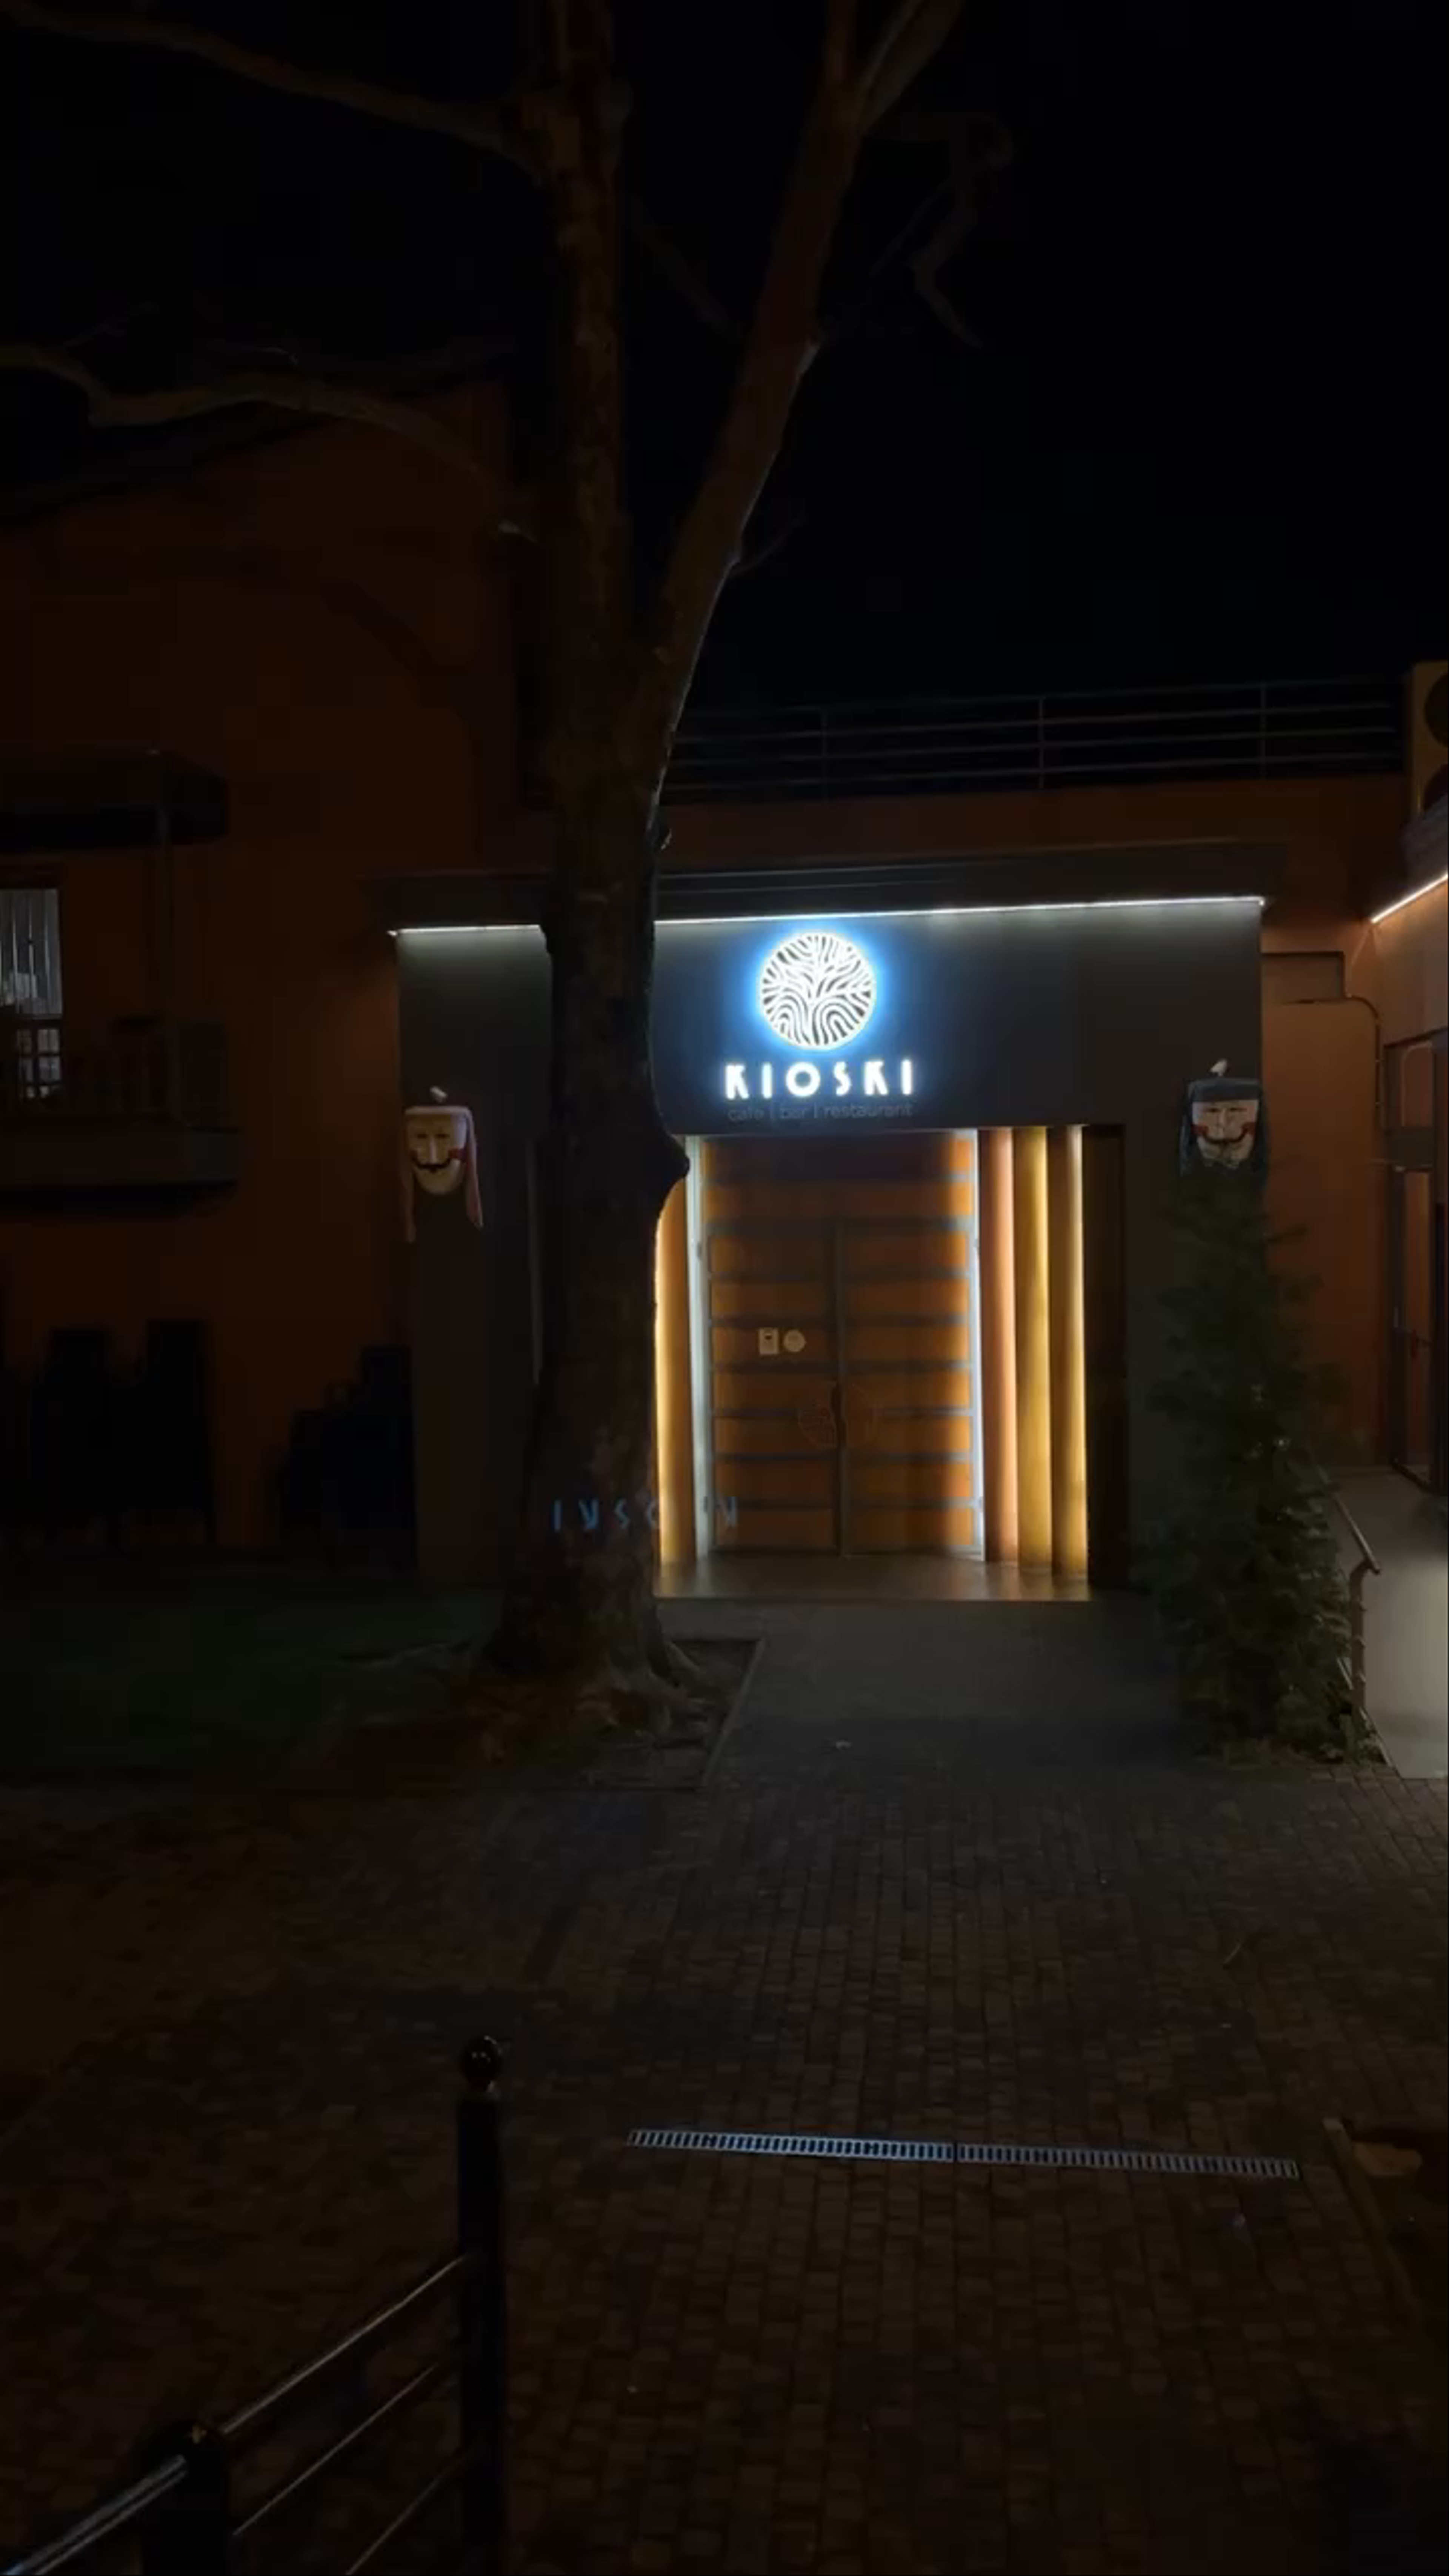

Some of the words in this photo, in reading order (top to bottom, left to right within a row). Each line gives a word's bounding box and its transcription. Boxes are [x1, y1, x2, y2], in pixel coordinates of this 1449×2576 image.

[725, 1060, 912, 1099] KIOSKI
[780, 1104, 809, 1120] bar
[823, 1102, 913, 1118] restaurant
